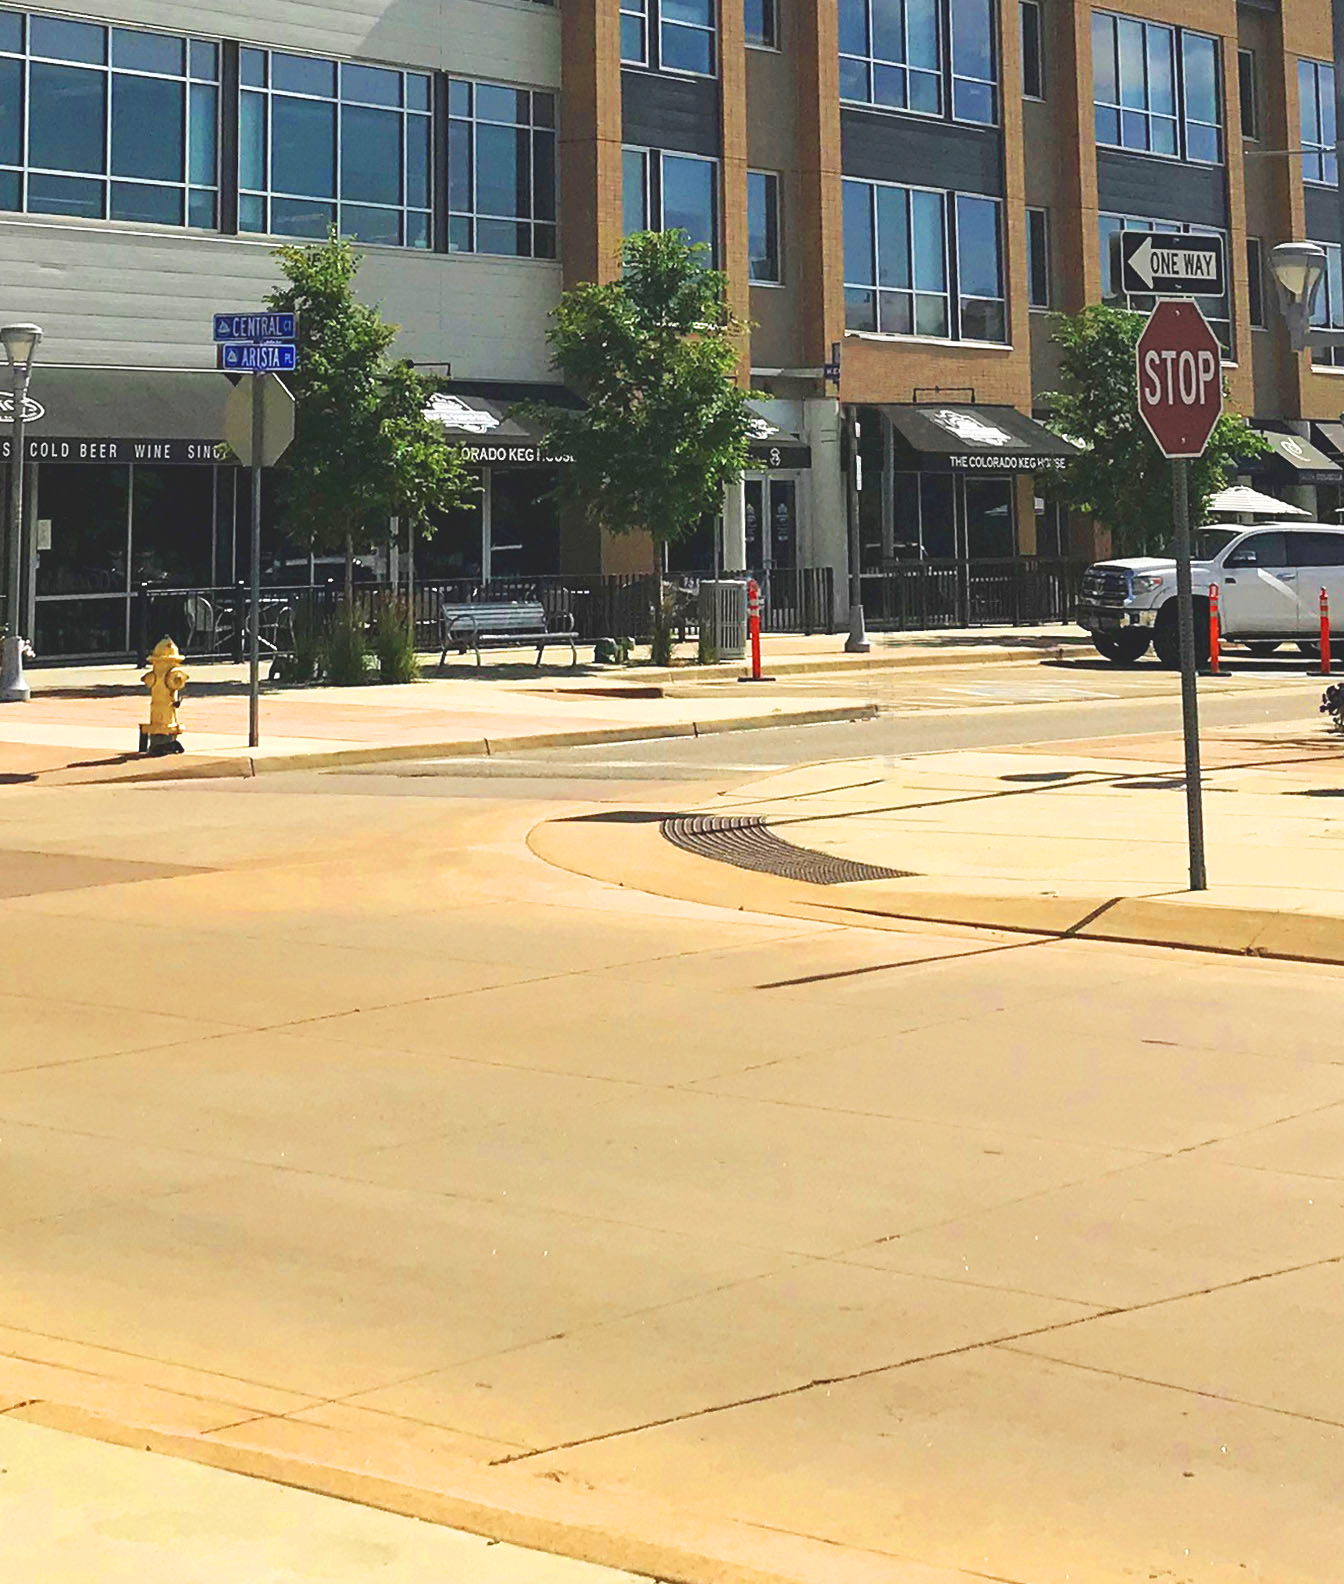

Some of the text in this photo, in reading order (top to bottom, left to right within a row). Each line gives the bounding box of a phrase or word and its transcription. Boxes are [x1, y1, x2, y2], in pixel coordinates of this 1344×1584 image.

[1150, 252, 1213, 277] ONE WAY
[232, 316, 282, 336] CENTRAL
[241, 347, 293, 367] ARISTA PL
[1144, 350, 1215, 406] STOP
[29, 442, 69, 458] COLD
[80, 443, 117, 458] BEER
[134, 444, 171, 459] WINE
[508, 448, 535, 462] KEG
[949, 456, 968, 468] THE
[968, 456, 1017, 468] COLORADO
[1018, 457, 1036, 469] KEG
